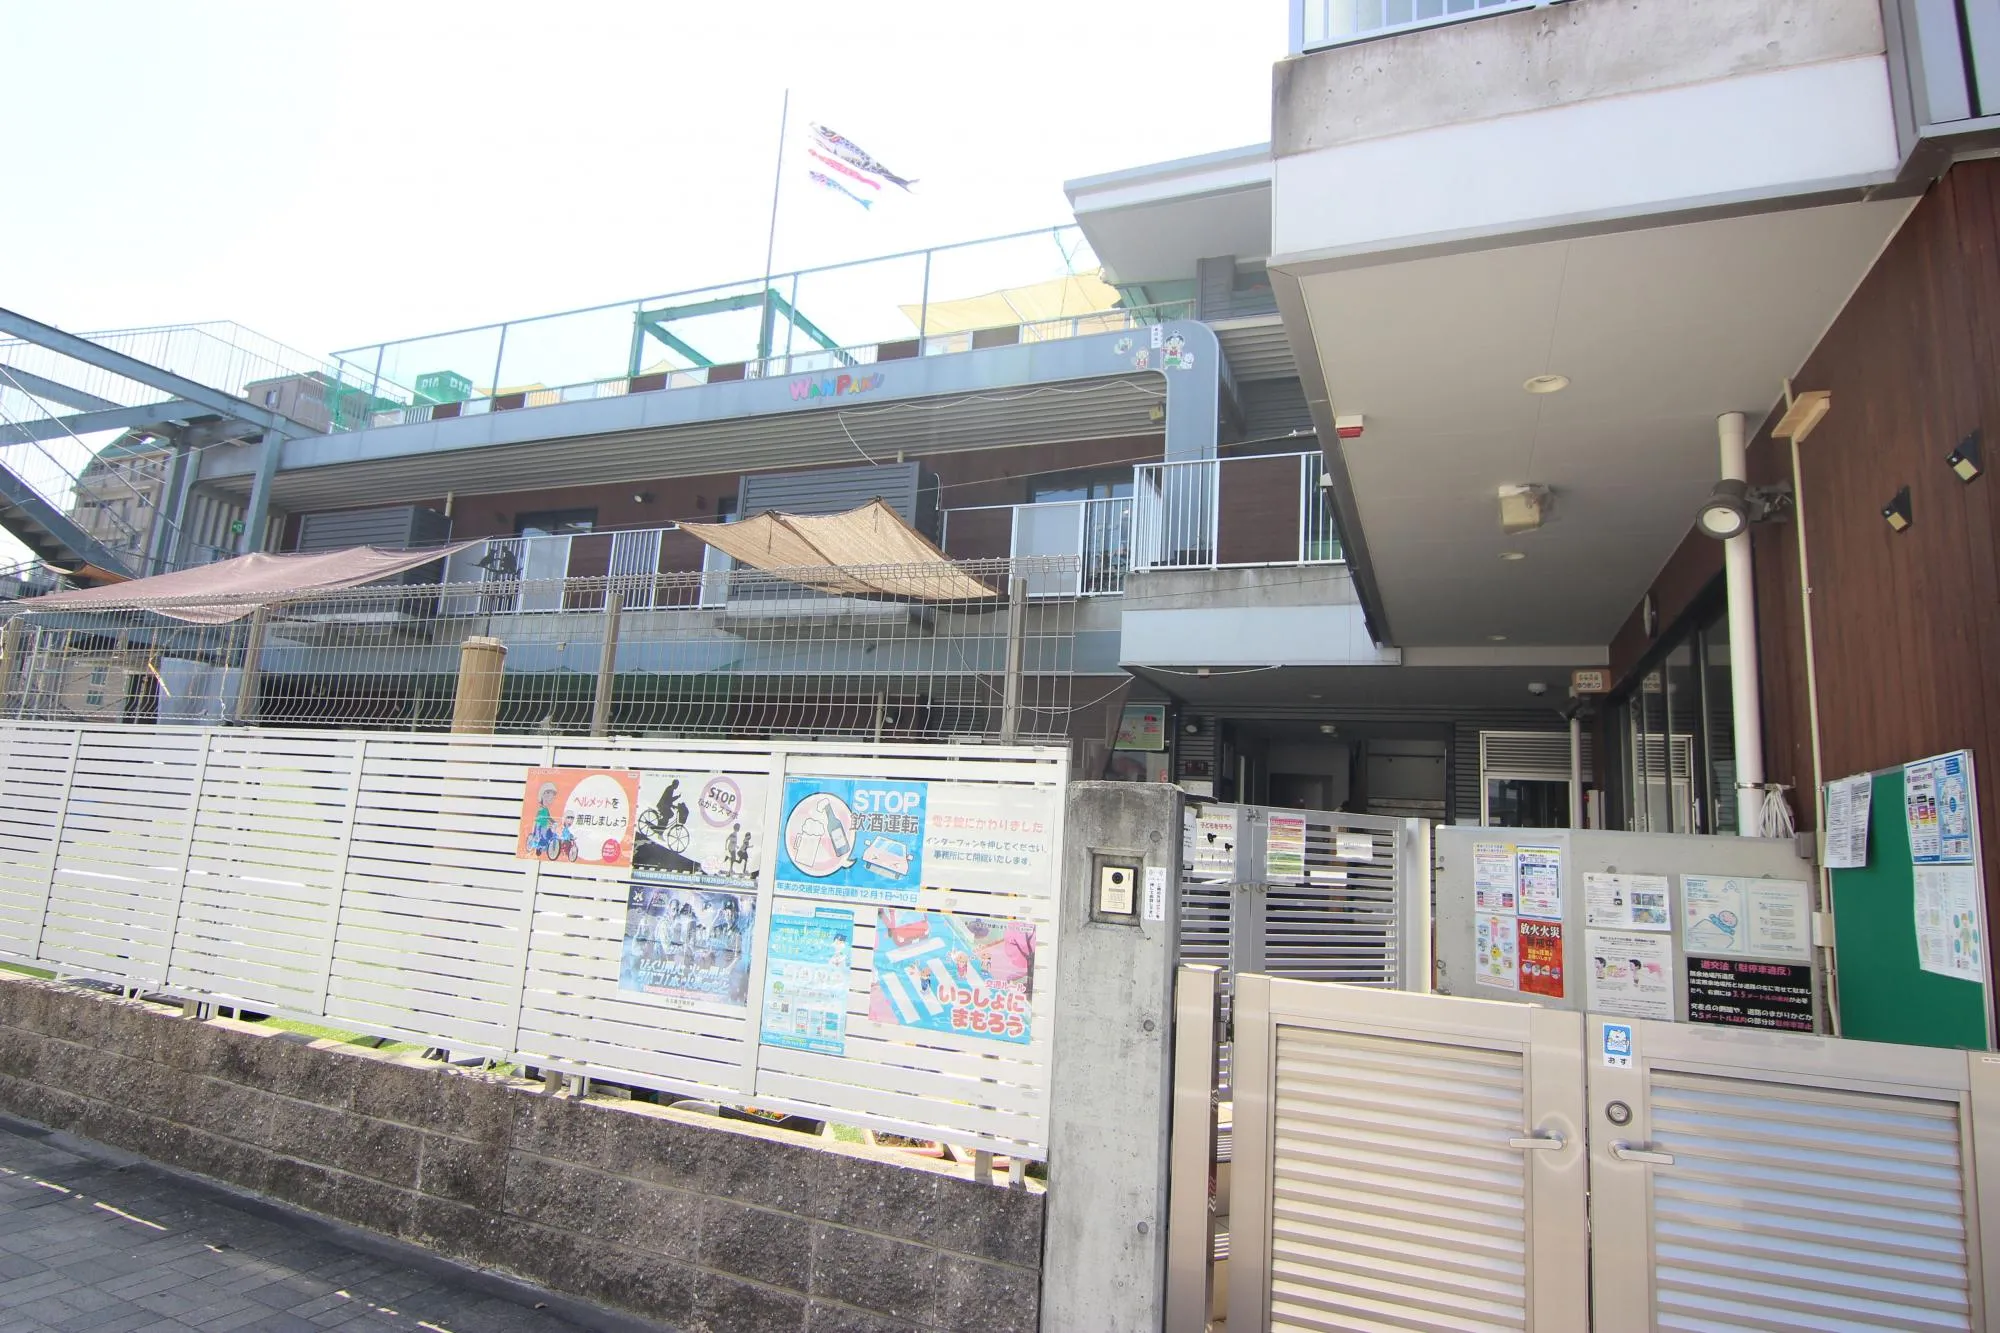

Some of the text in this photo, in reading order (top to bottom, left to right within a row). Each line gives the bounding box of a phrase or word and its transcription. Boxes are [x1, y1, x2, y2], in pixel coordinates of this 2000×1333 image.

[574, 796, 619, 809] ヘルメットを
[709, 787, 736, 805] STOP
[853, 789, 920, 813] STOP
[697, 798, 739, 820] ながらスマホ
[576, 814, 627, 828] 着用しましょう
[850, 813, 919, 835] 飲酒運転
[939, 984, 1025, 1013] いっしょに
[952, 1007, 1024, 1037] まもろう
